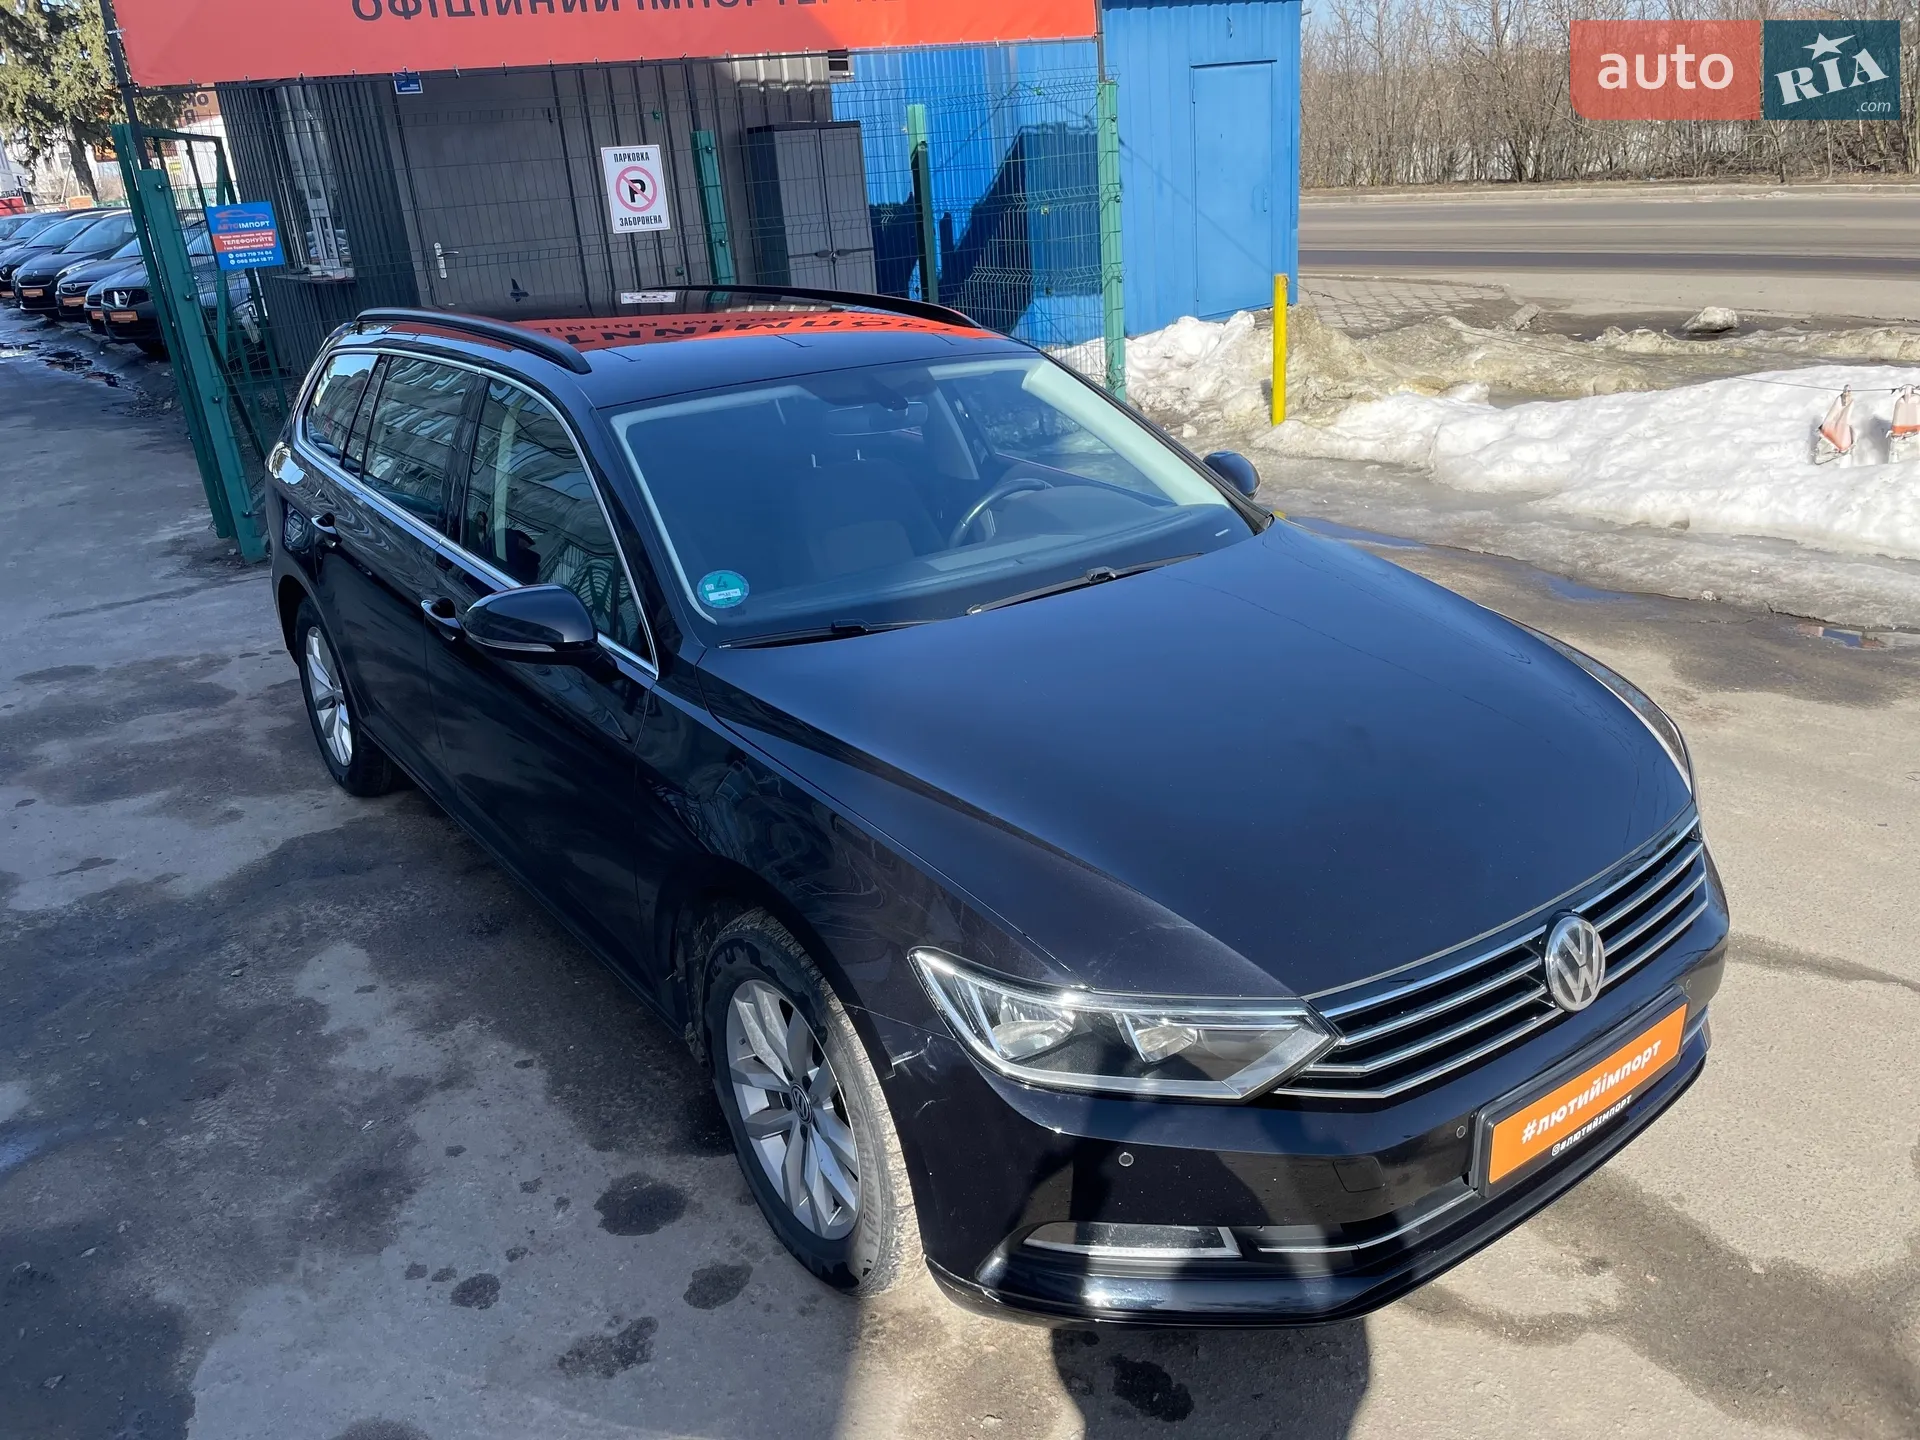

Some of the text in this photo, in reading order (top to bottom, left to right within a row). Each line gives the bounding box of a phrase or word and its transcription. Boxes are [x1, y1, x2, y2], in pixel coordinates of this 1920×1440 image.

[613, 151, 650, 162] ПАРКОВКА
[619, 214, 663, 226] ЗАБОРОНЕНА
[222, 236, 273, 246] ТЕЛЕФОНУЙТЕ
